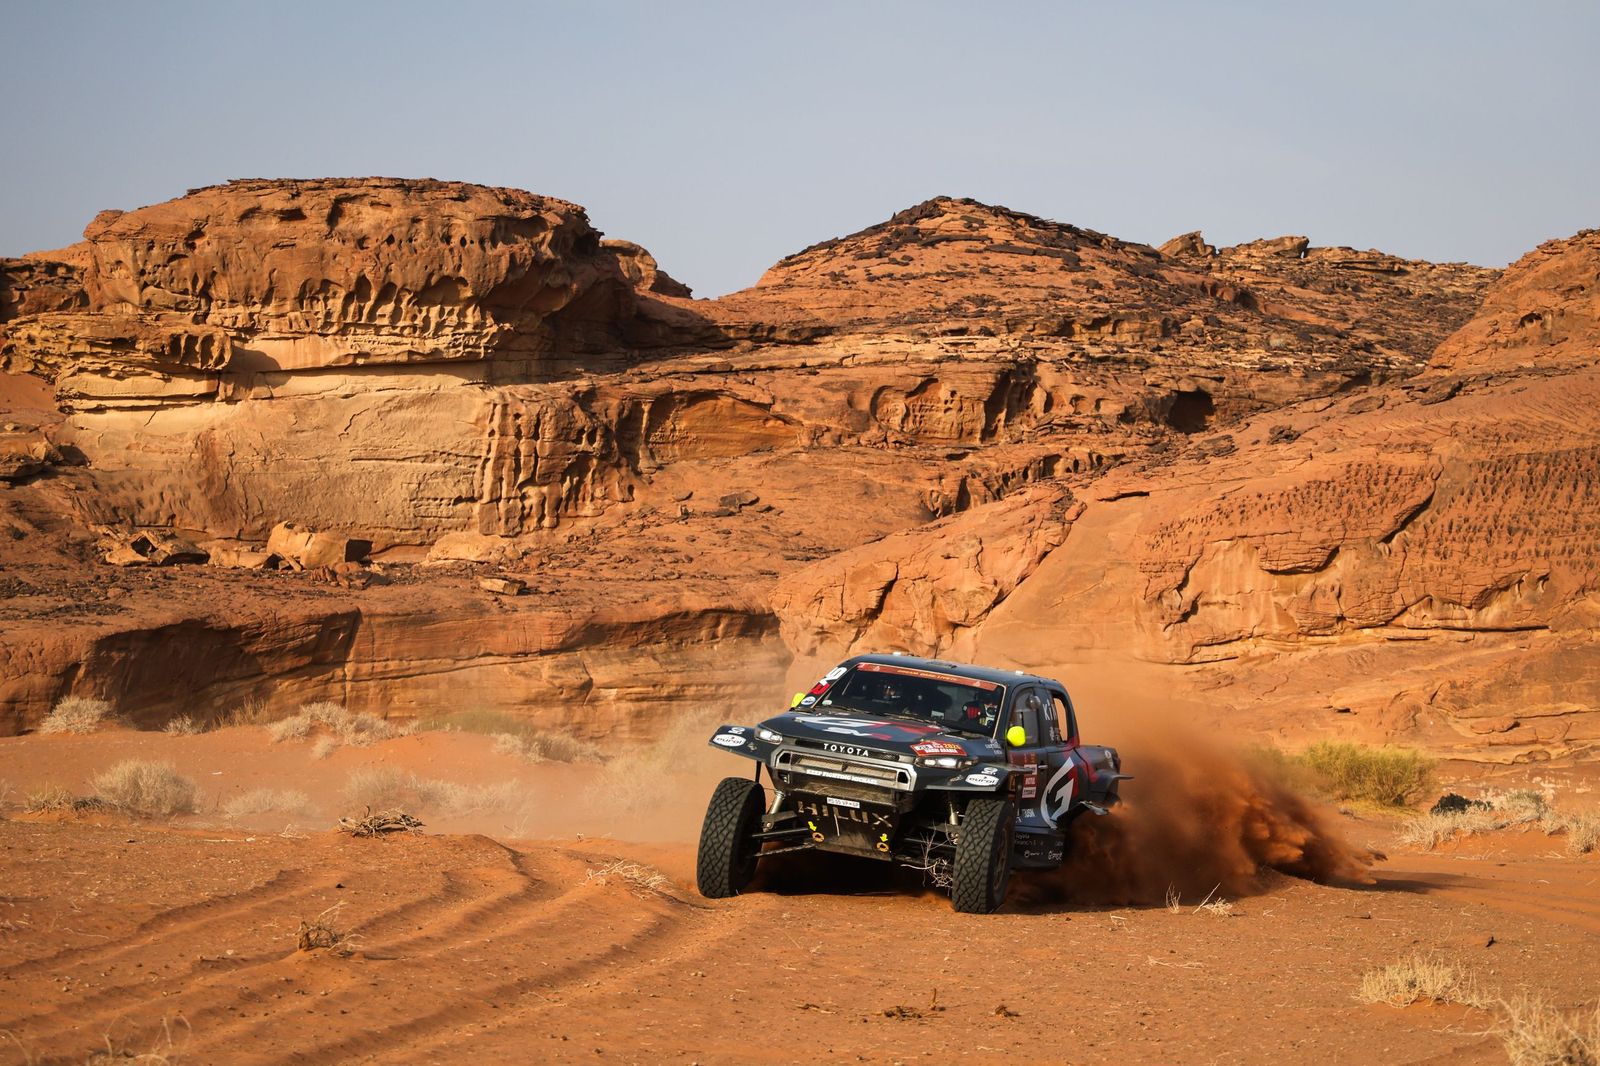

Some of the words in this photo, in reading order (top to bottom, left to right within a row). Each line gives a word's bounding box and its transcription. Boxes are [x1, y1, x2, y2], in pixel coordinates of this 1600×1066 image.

[716, 736, 743, 744] eurol
[823, 743, 869, 757] TOYOTA
[822, 771, 851, 780] FIGHTING
[969, 776, 995, 784] eurol
[797, 801, 893, 828] HILUX
